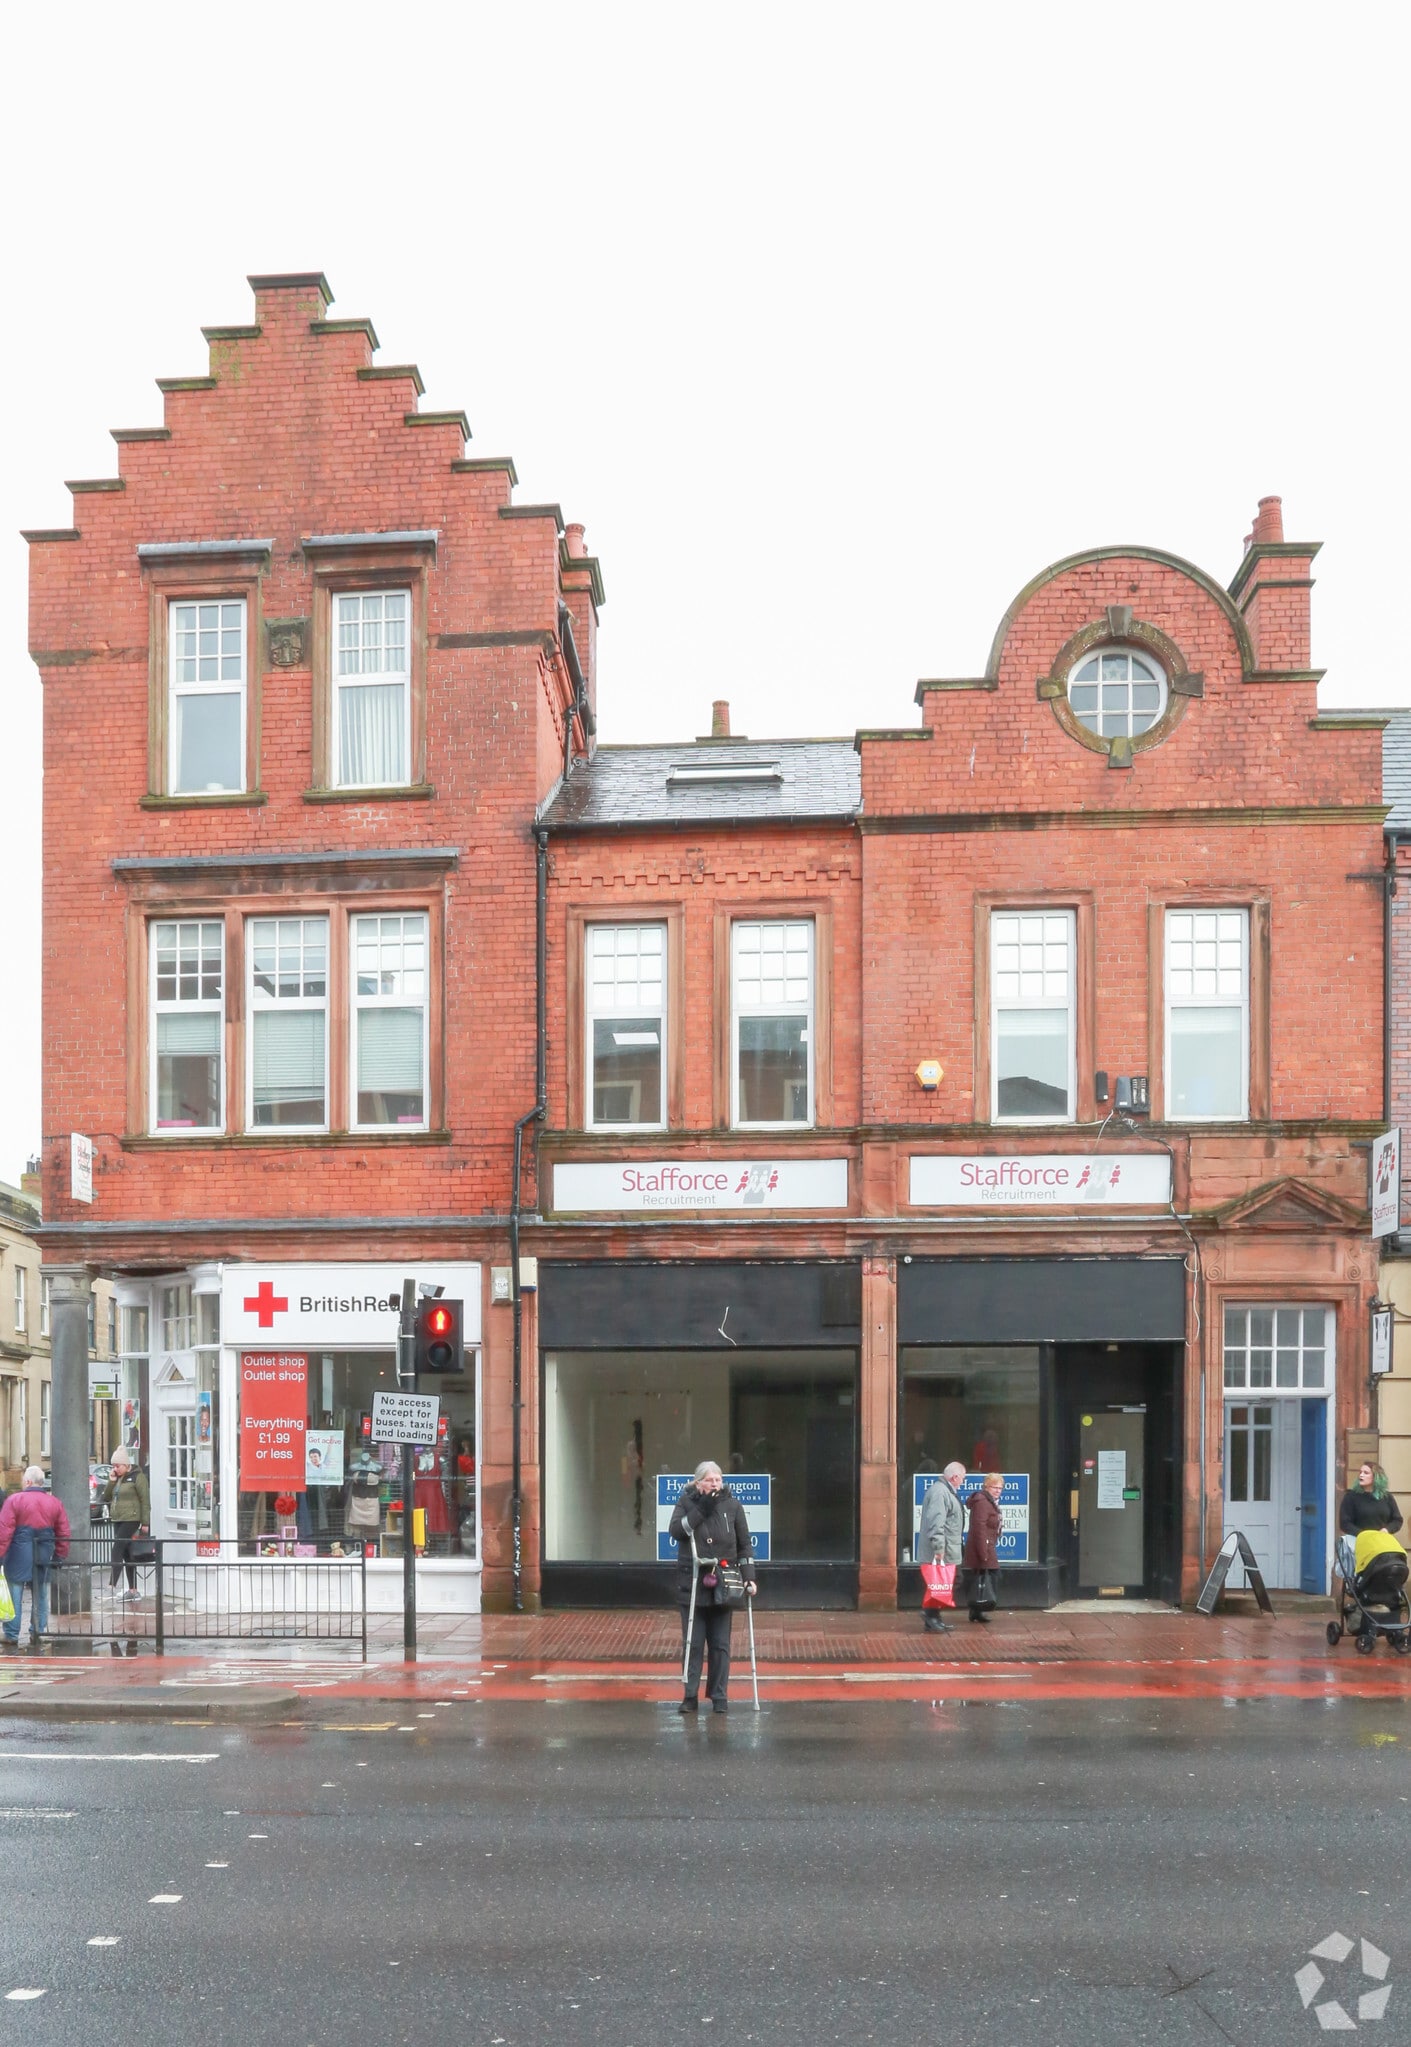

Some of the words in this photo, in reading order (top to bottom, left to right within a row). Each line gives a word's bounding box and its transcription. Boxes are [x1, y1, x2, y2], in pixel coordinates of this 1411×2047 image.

[622, 1168, 728, 1191] Stafforce
[960, 1162, 1069, 1186] Stafforce
[642, 1194, 716, 1205] Recruitment
[981, 1189, 1056, 1200] Recruitment
[244, 1356, 276, 1367] Outlet
[279, 1356, 305, 1368] shop
[244, 1370, 276, 1381] Outlet
[279, 1371, 305, 1383] shop
[381, 1396, 395, 1405] No
[398, 1399, 432, 1408] access
[380, 1408, 413, 1418] except
[417, 1410, 431, 1418] for
[245, 1417, 304, 1430] Everything
[410, 1420, 434, 1429] taxis
[259, 1433, 290, 1443] £1.99
[308, 1436, 320, 1444] Get
[375, 1429, 393, 1437] and
[397, 1430, 433, 1441] loading
[256, 1450, 268, 1459] or
[270, 1448, 293, 1459] less
[200, 1545, 219, 1557] shop
